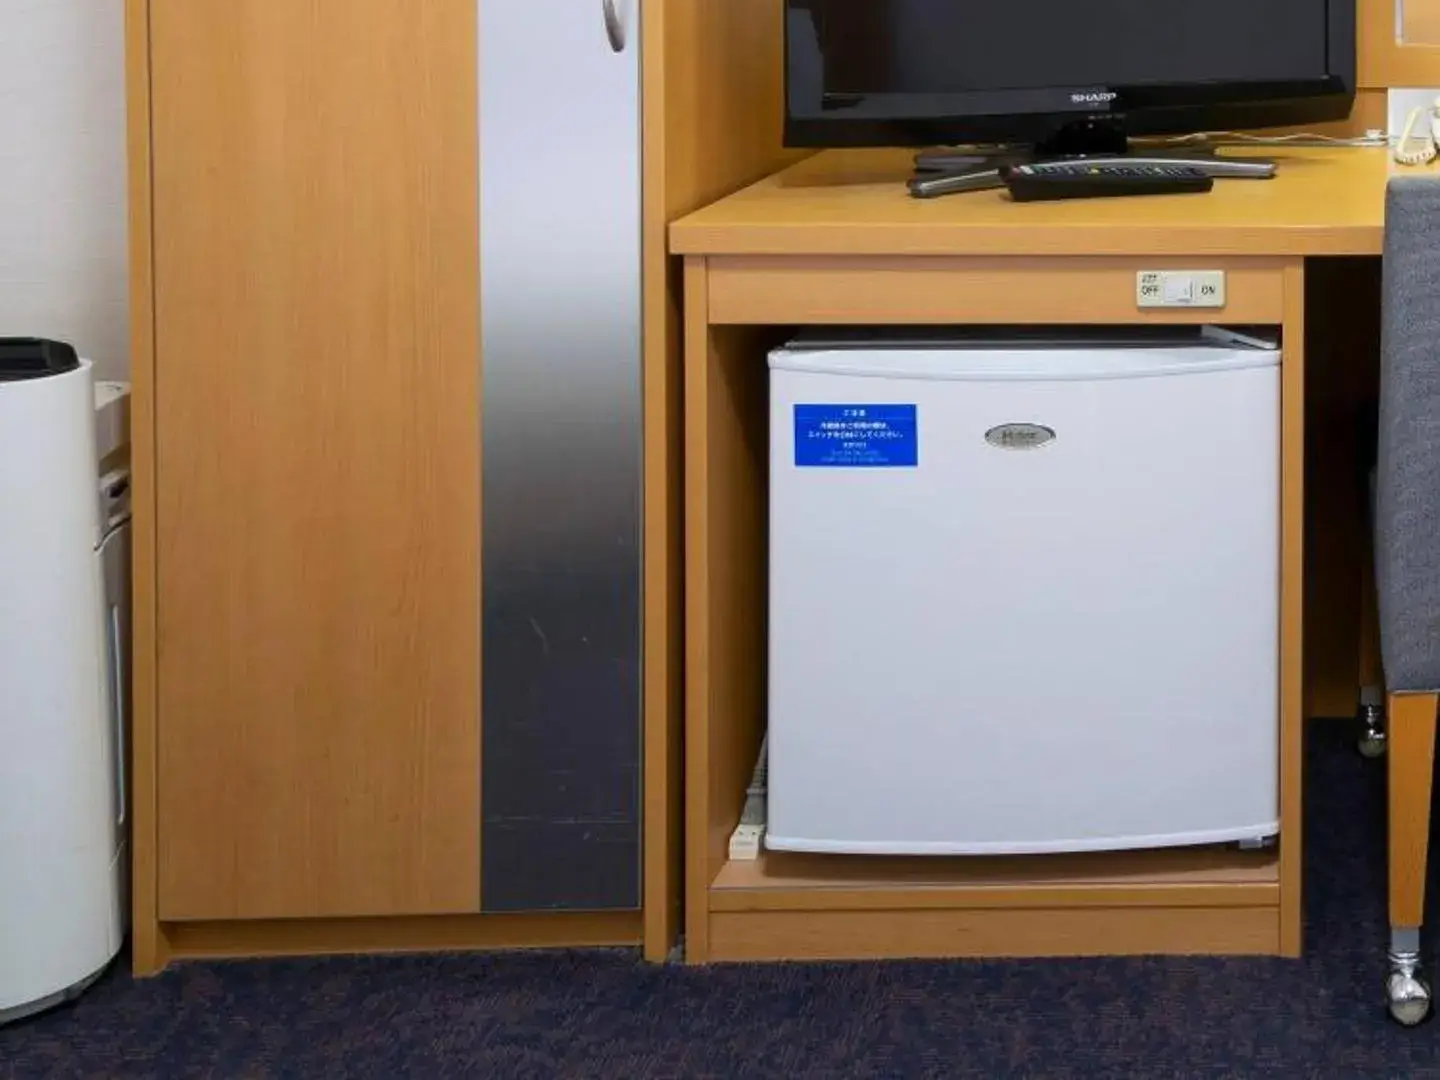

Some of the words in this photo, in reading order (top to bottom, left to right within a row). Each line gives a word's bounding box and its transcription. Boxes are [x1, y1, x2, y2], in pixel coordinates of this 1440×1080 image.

[1071, 93, 1116, 103] SHARP
[1141, 284, 1158, 295] OFF
[1201, 285, 1216, 295] ON
